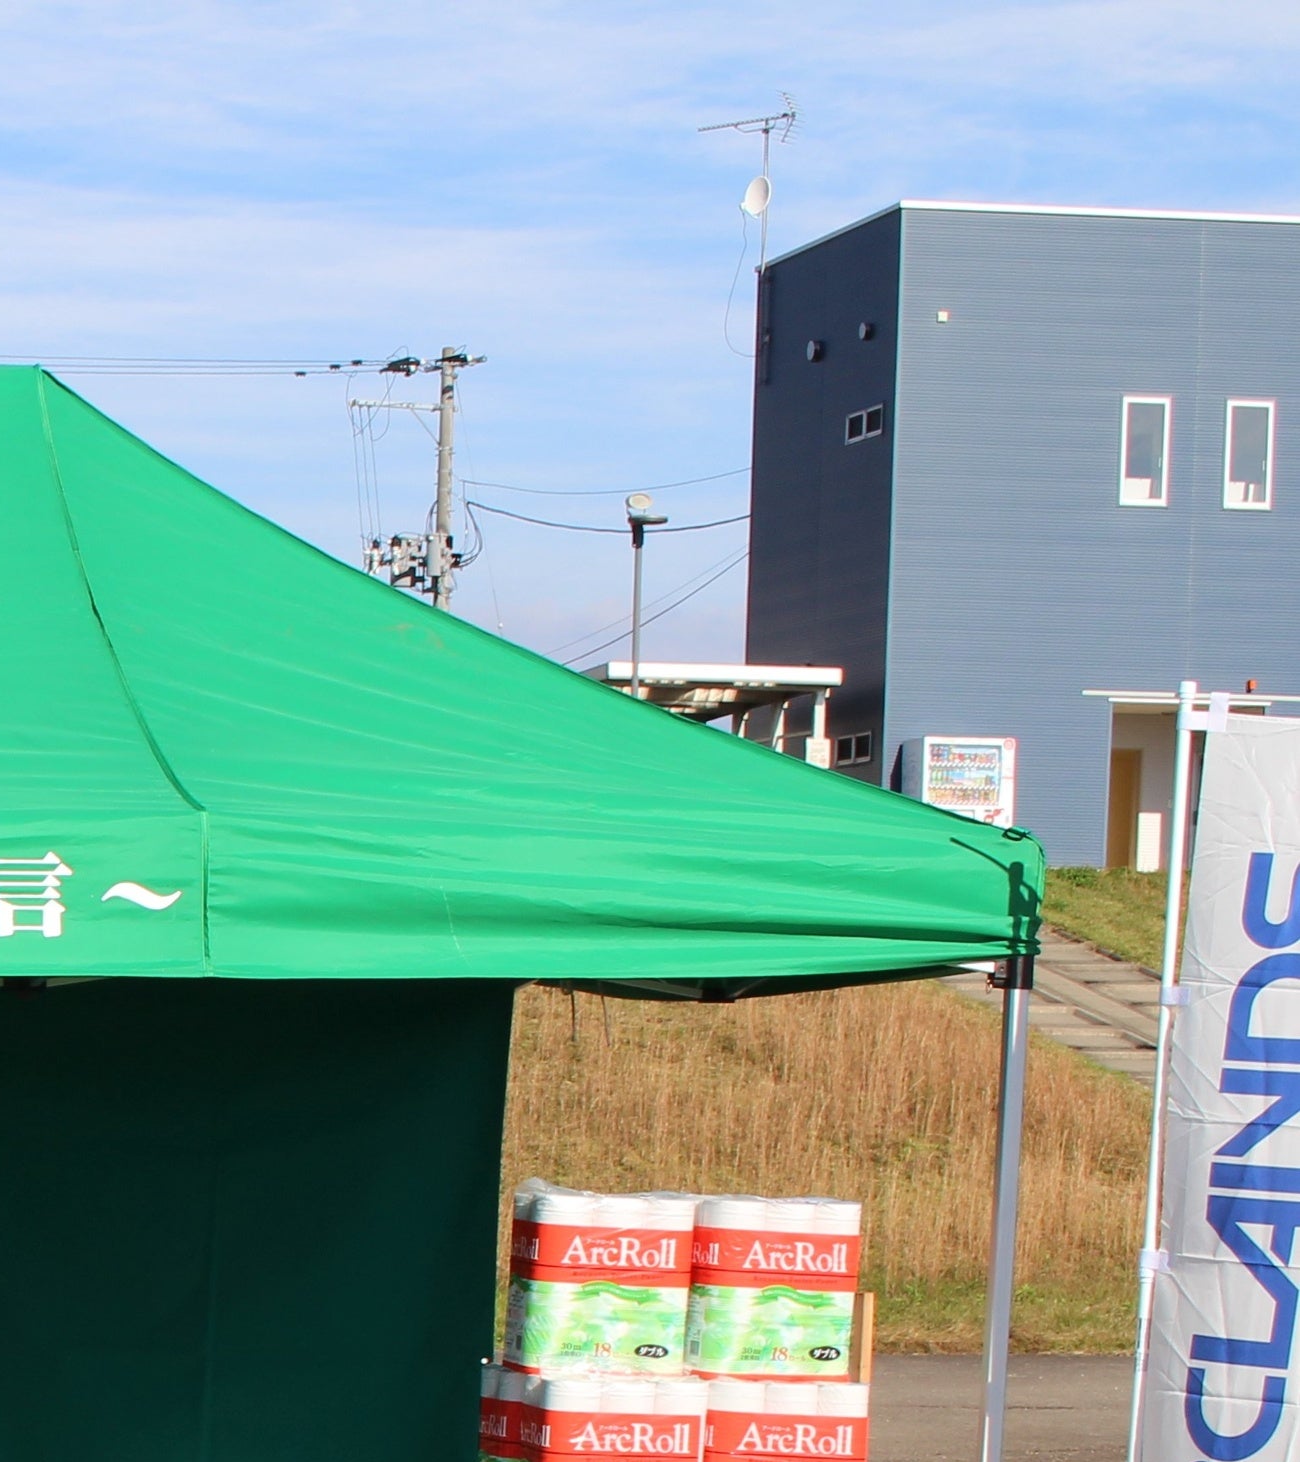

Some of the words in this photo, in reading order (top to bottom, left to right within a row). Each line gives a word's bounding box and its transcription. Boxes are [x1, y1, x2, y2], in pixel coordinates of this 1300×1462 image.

[561, 1235, 677, 1268] ArcRoll
[742, 1240, 848, 1273] ArcRoll
[573, 1422, 690, 1454] ArcRoll
[736, 1422, 854, 1456] ArcRoll
